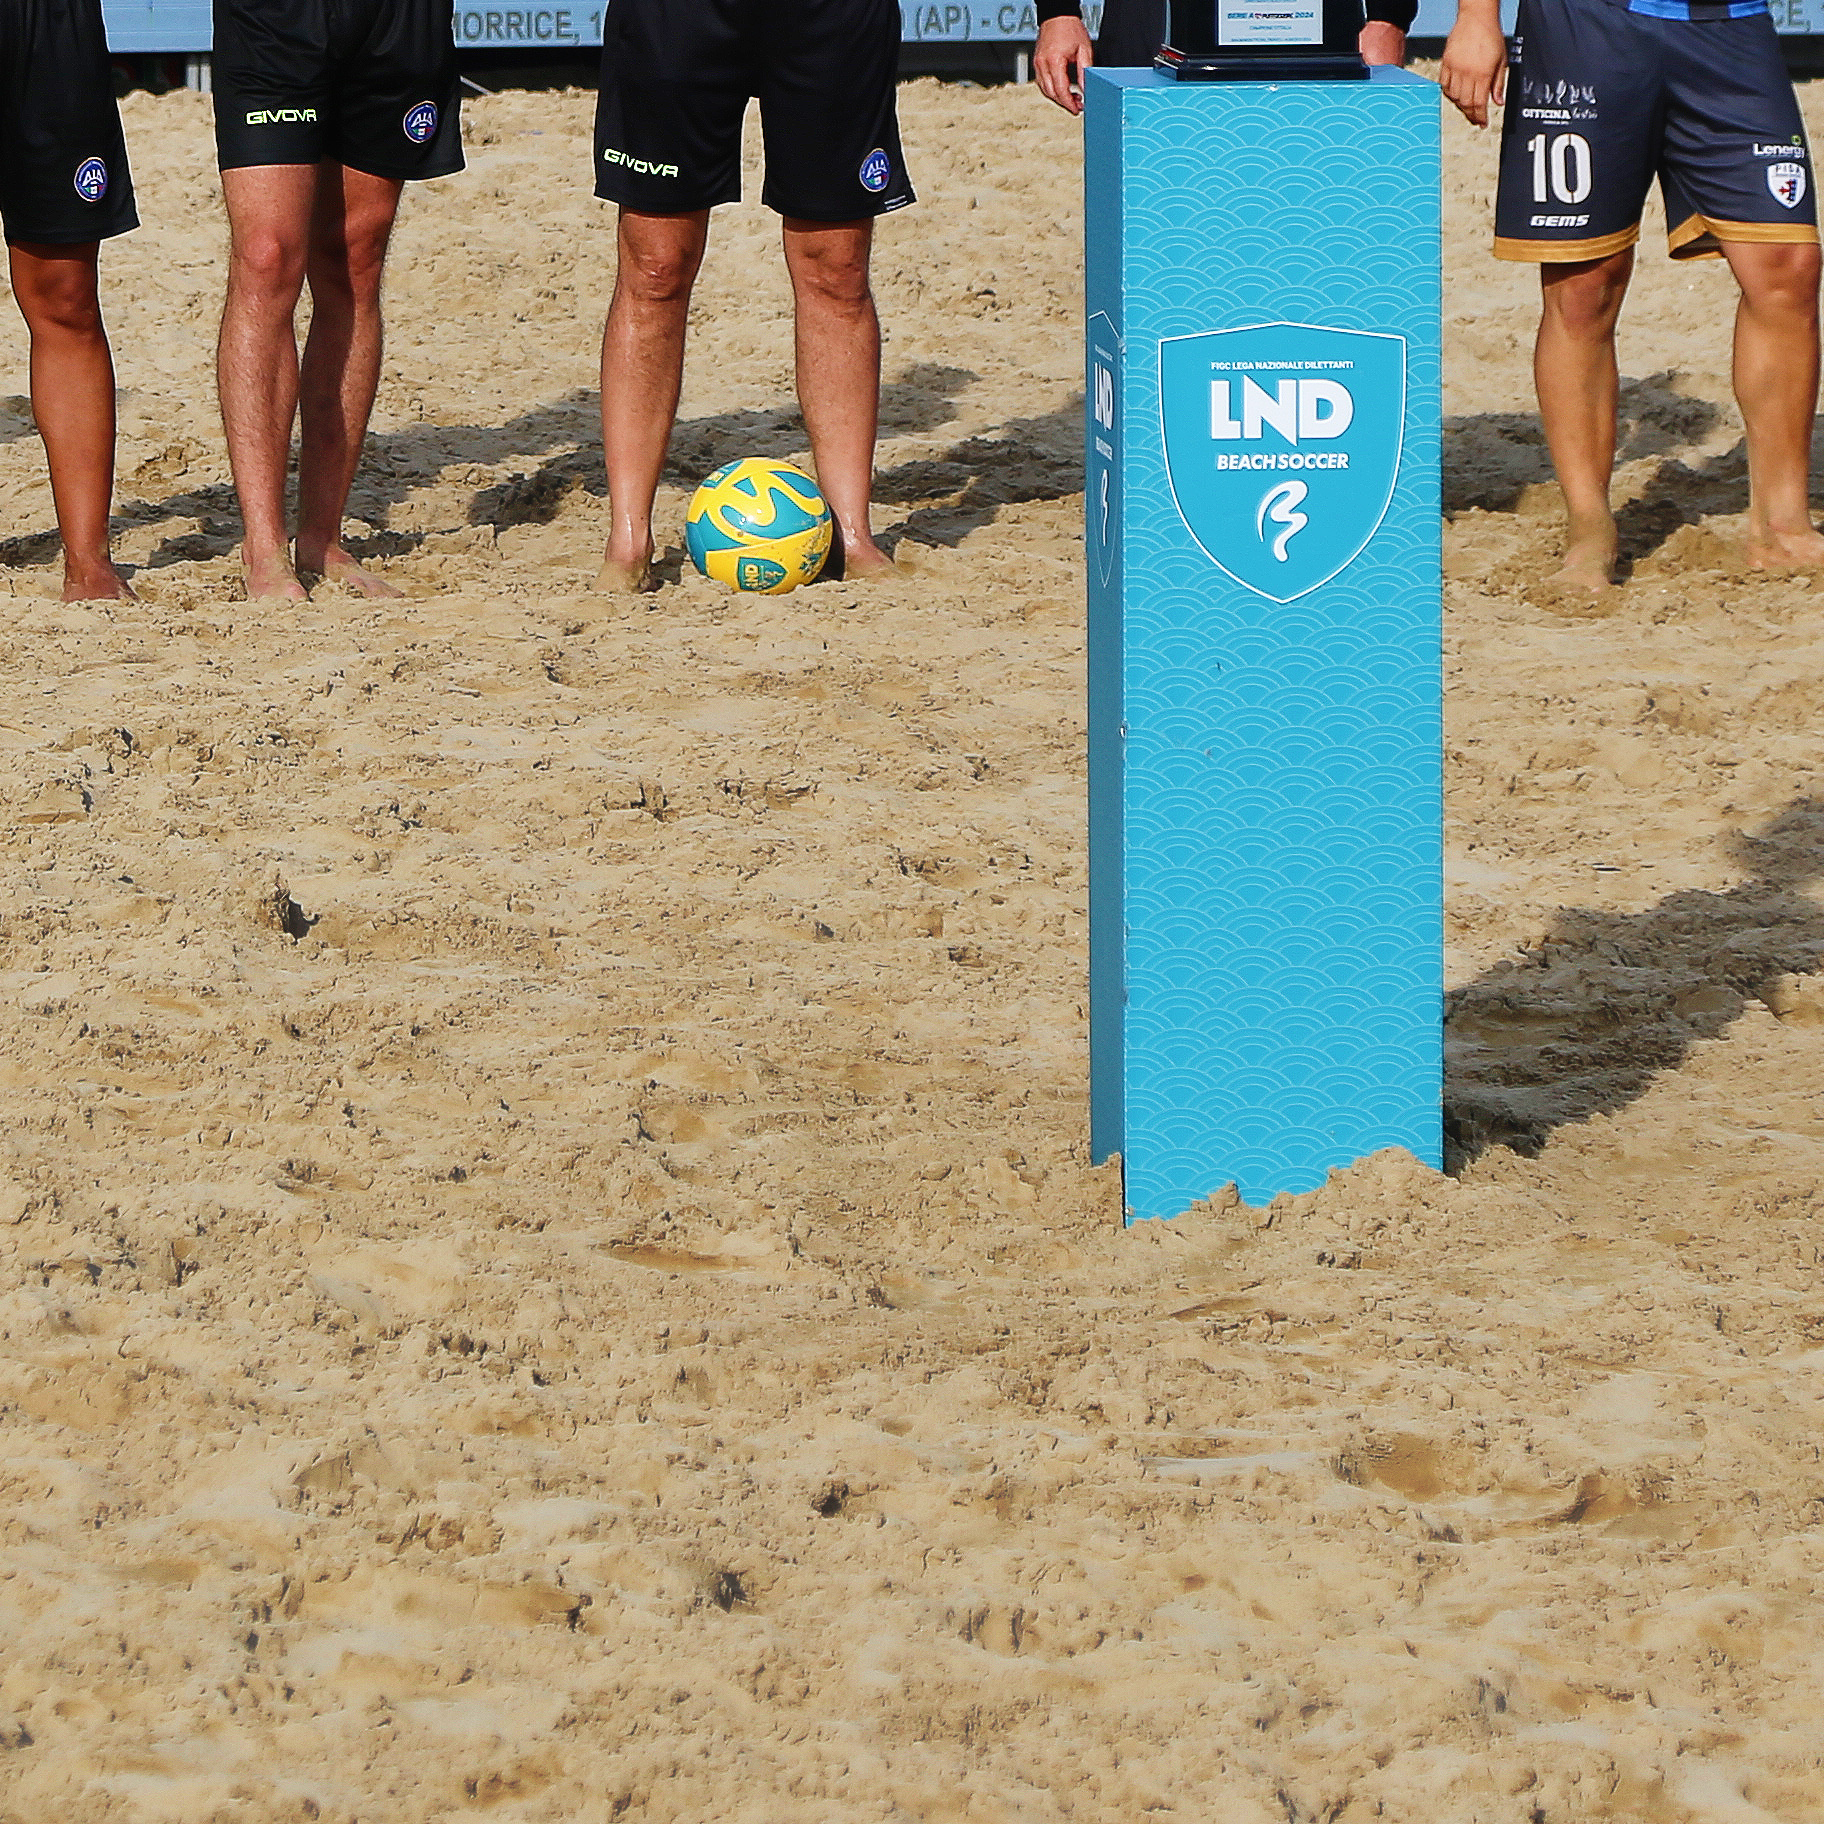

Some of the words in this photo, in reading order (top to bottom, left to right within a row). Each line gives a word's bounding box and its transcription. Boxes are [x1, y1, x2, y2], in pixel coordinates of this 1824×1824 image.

[451, 6, 581, 45] ORRICE,
[914, 4, 972, 43] (AP)
[246, 108, 316, 125] GIVOVA
[603, 147, 679, 179] GIVOVA
[1528, 133, 1592, 204] 10
[1530, 215, 1589, 227] GEMS
[1211, 361, 1231, 371] FIGC
[1232, 361, 1254, 371] LEGA
[1255, 361, 1304, 370] NAZIONALE
[1305, 360, 1354, 369] DILETTANTI
[1211, 374, 1354, 447] LND
[1217, 454, 1276, 470] BEACH
[1278, 453, 1349, 470] SOCCER
